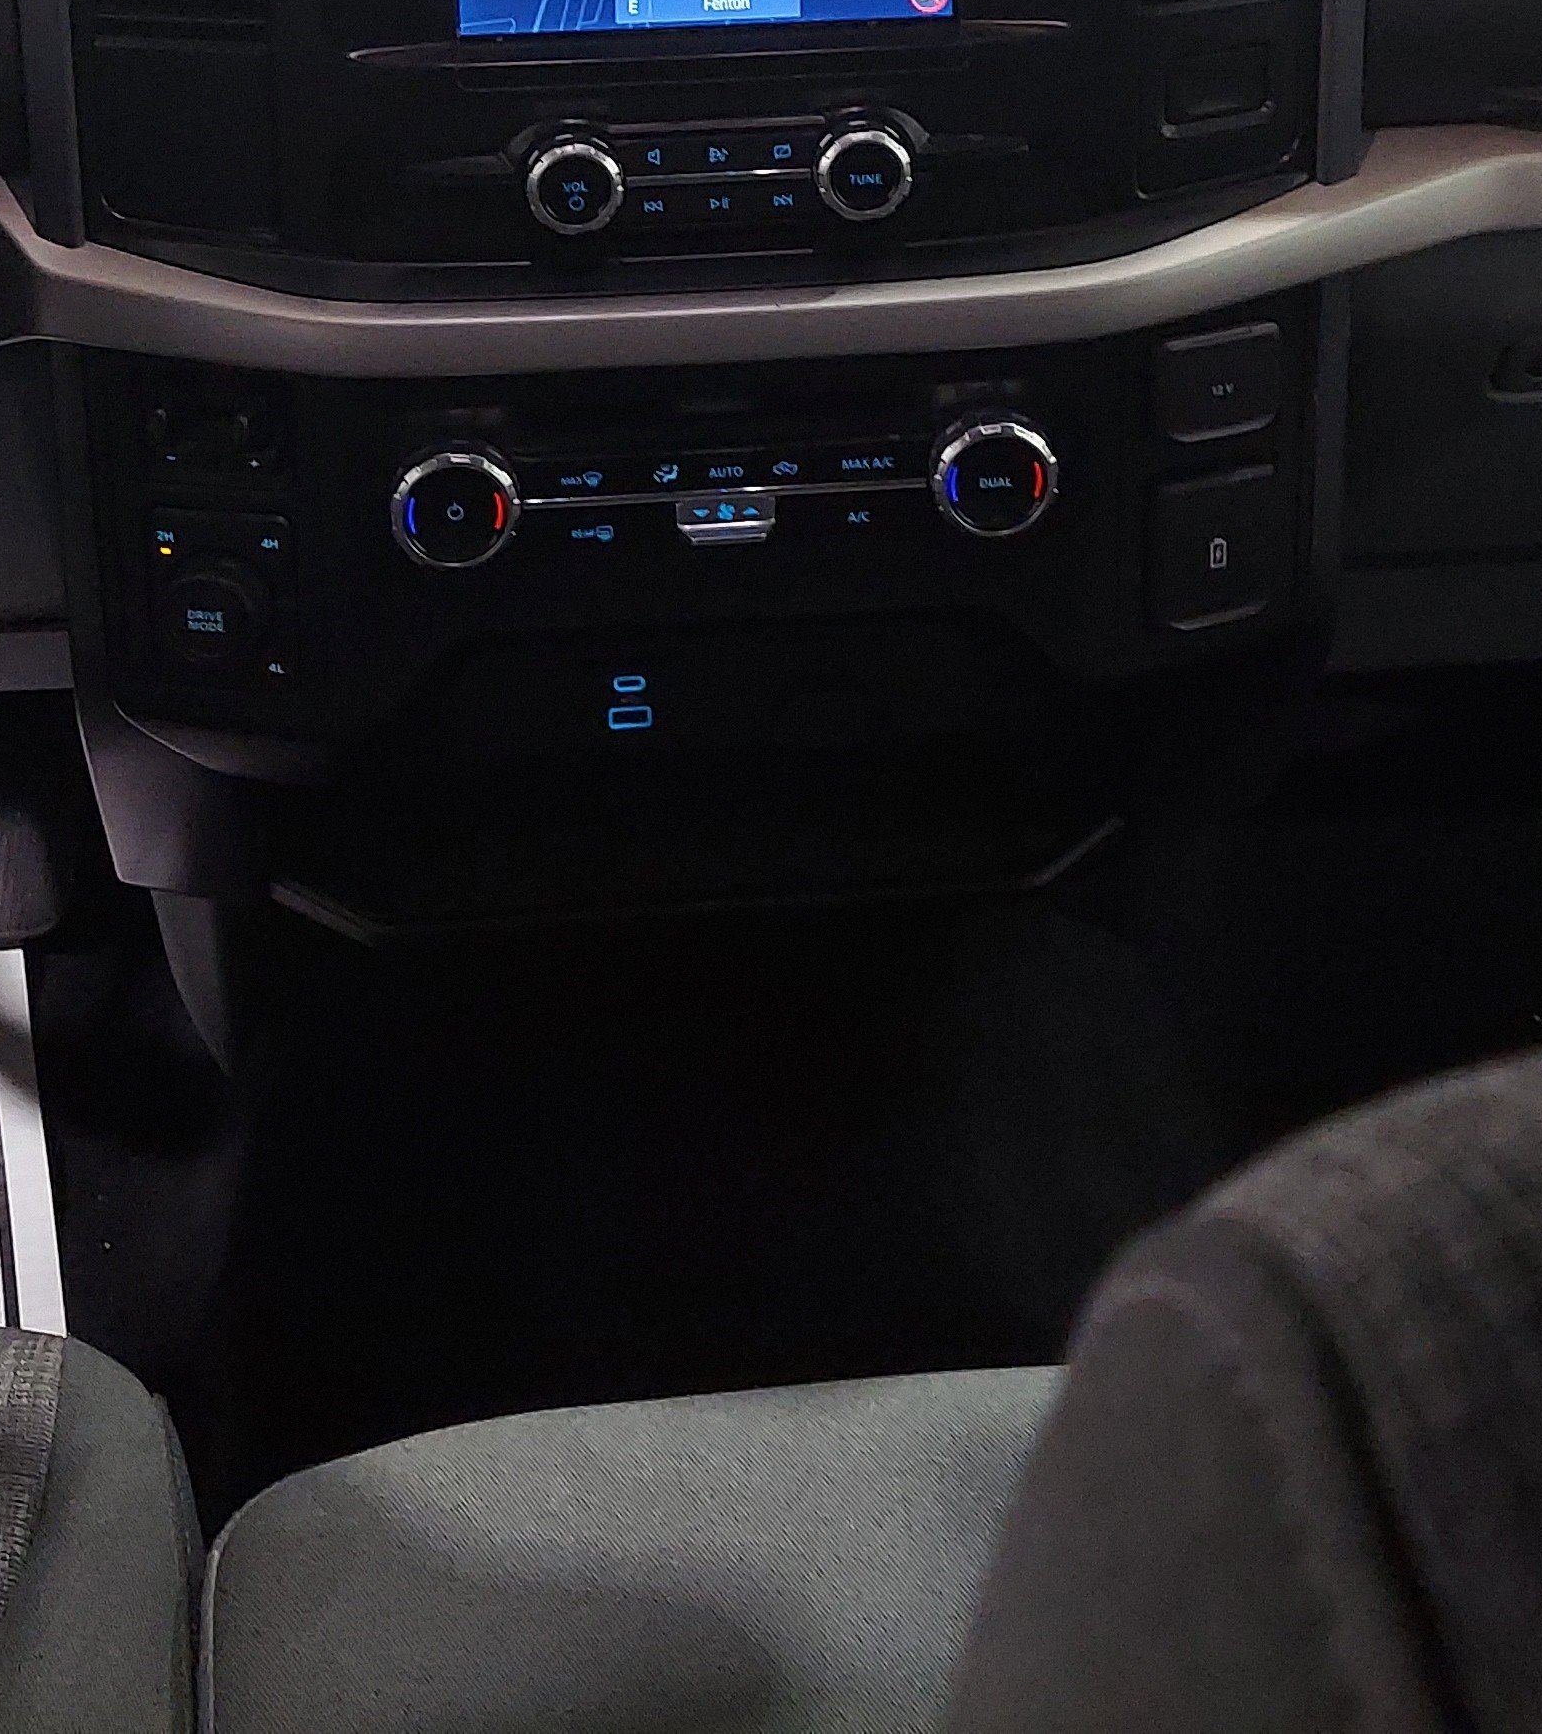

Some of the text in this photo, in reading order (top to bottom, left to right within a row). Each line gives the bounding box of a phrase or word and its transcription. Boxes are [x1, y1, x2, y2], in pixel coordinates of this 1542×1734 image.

[849, 173, 884, 188] TUNE
[561, 181, 589, 194] VOL
[872, 455, 896, 469] A/C
[708, 465, 745, 479] AUTO
[979, 476, 1014, 489] DUAL
[847, 510, 871, 524] A/C
[186, 609, 224, 621] DRIVE
[186, 620, 226, 633] MODE
